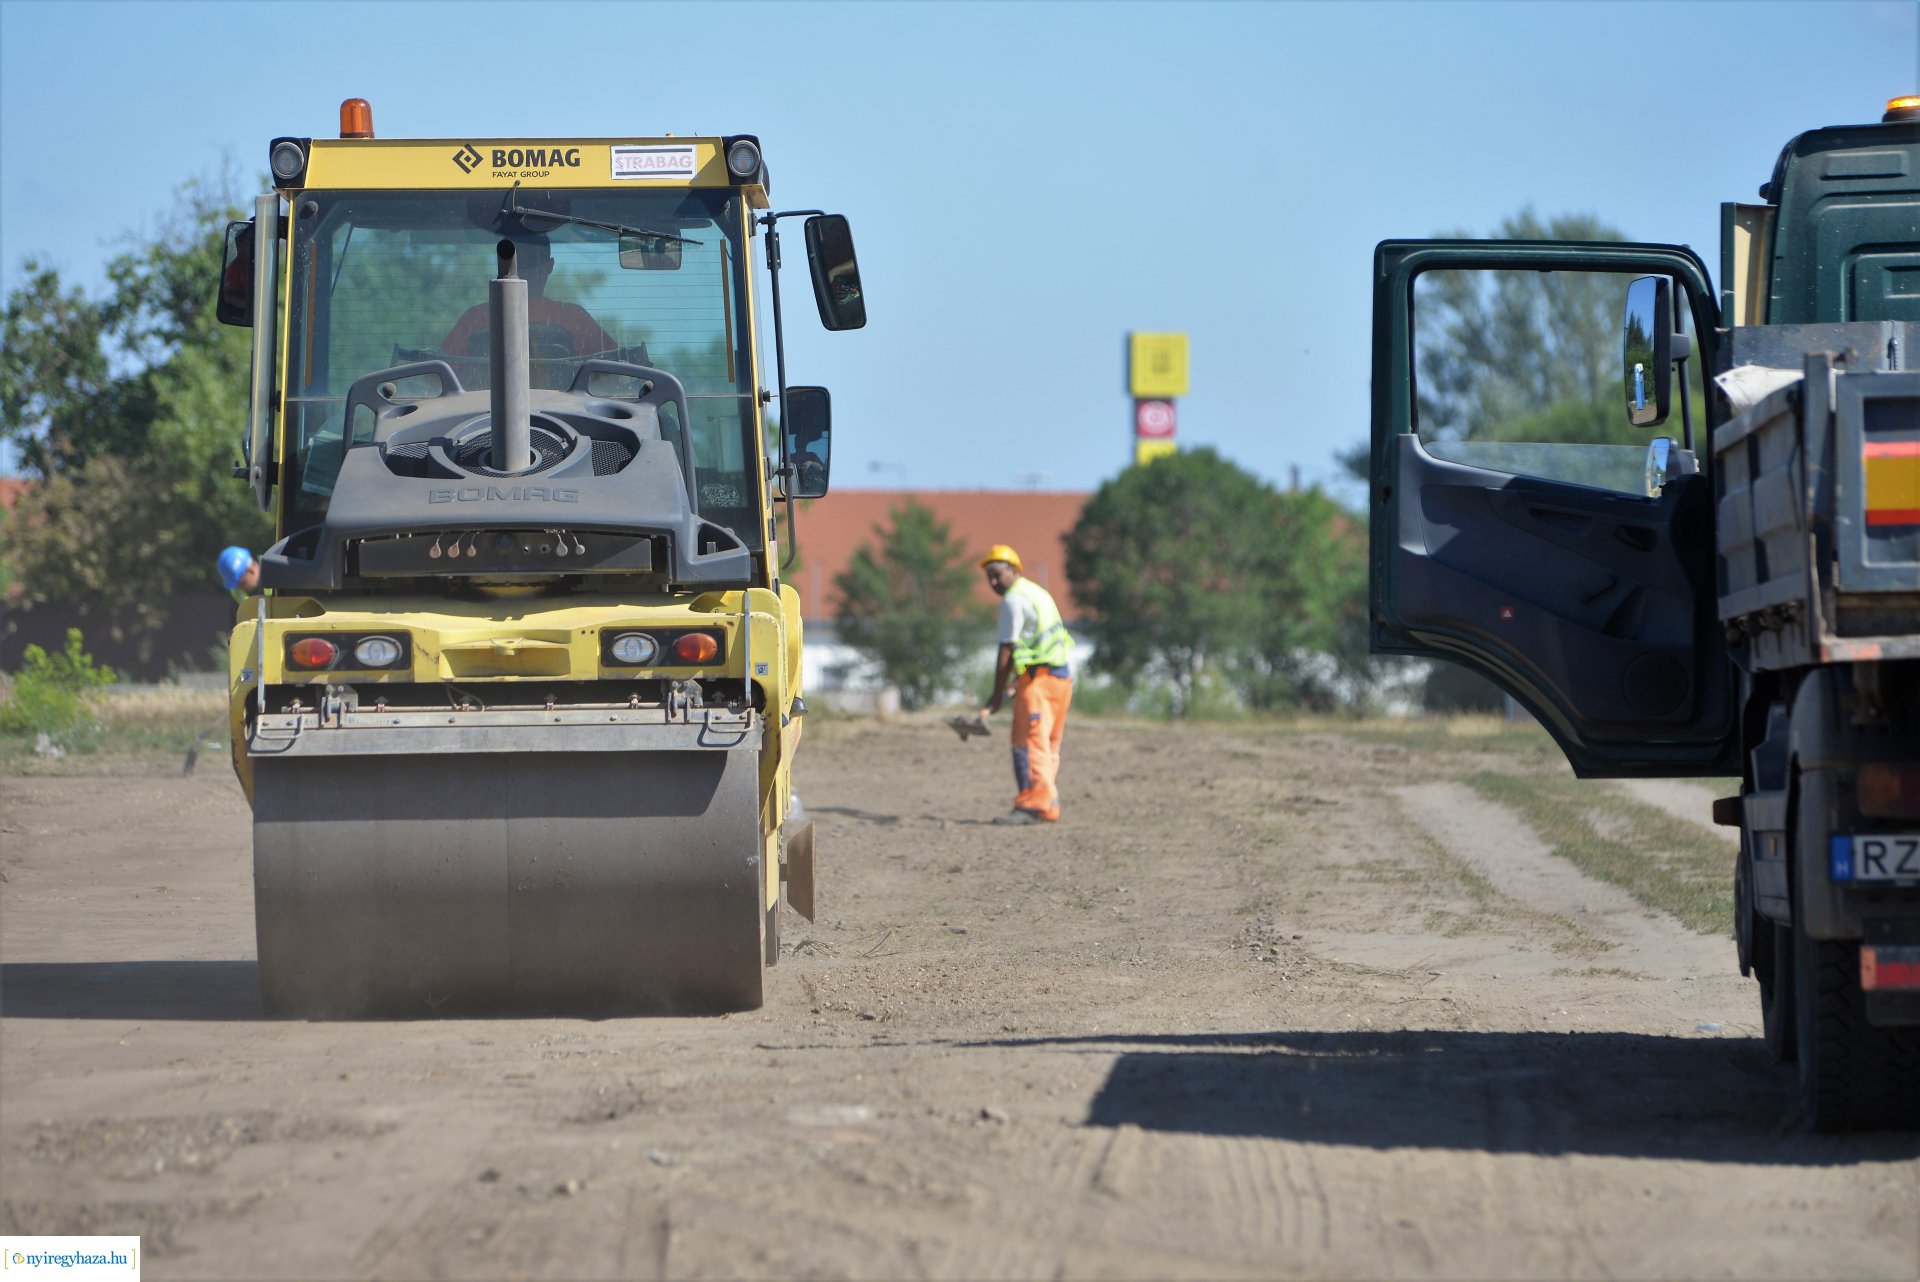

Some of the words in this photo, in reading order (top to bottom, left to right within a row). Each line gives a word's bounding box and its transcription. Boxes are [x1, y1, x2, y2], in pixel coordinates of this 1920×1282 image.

[492, 148, 581, 168] BOMAG
[615, 154, 693, 169] STRABAG
[429, 486, 580, 504] BOMAG
